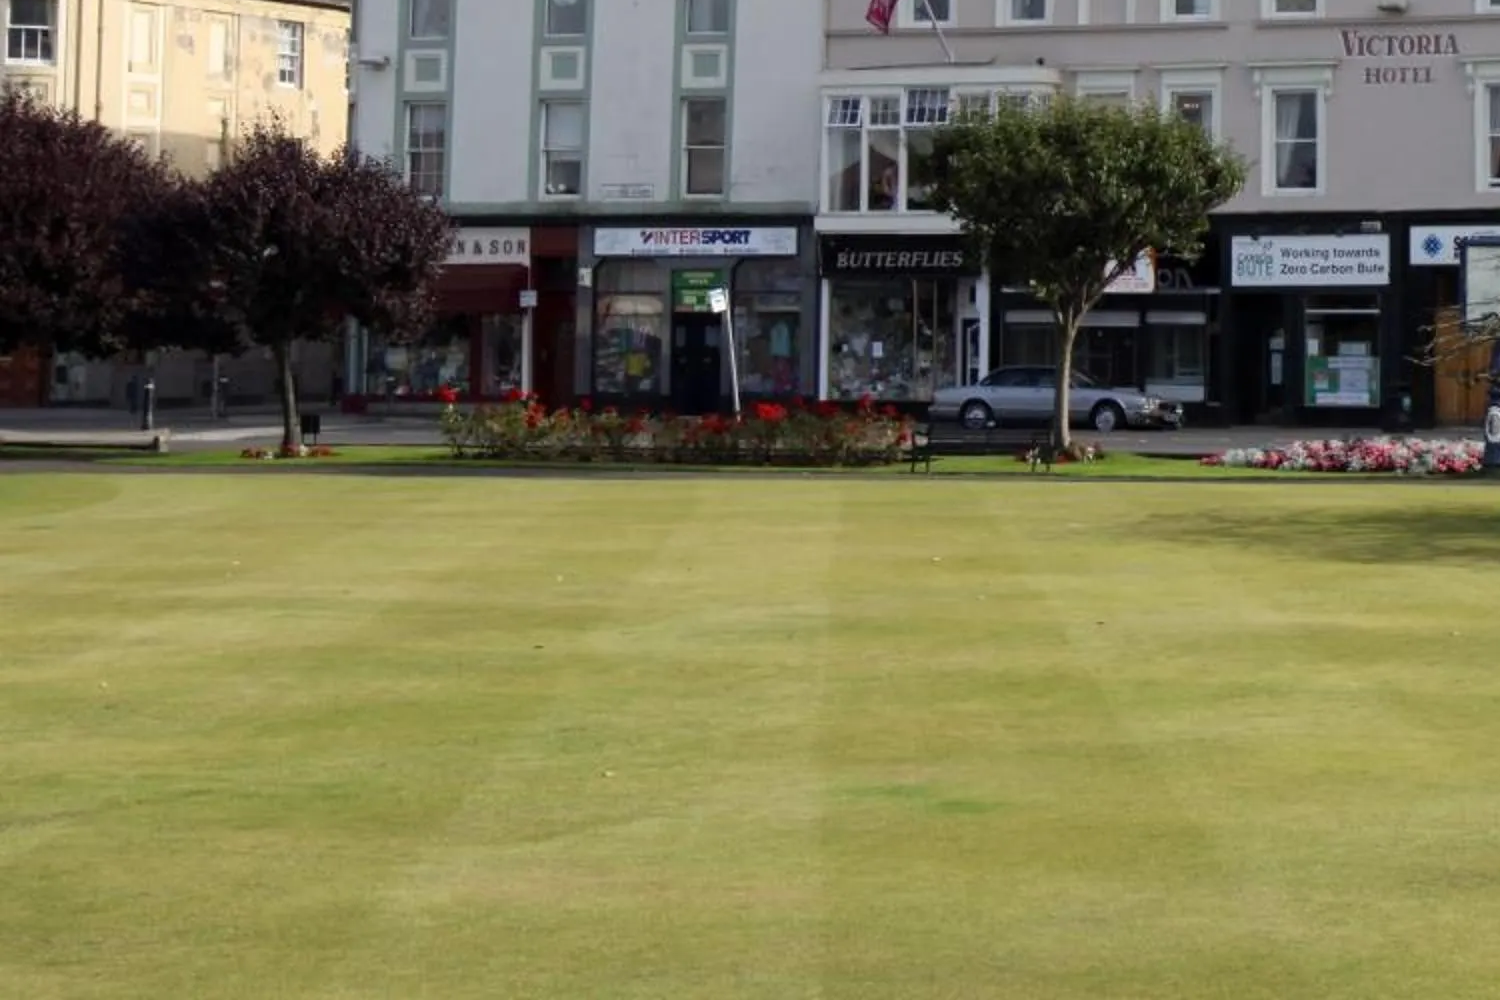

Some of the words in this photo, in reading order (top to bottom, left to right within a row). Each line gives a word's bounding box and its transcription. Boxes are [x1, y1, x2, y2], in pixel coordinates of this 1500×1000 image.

[1341, 30, 1460, 56] VICTORIA
[1364, 66, 1432, 84] HOTEL
[654, 230, 752, 245] INTERSPORT
[488, 239, 526, 256] SON
[1279, 247, 1330, 261] Working
[1333, 247, 1381, 258] towards
[836, 251, 963, 268] BUTTERFLIES
[1279, 263, 1307, 274] Zero
[1310, 262, 1353, 275] Carbon
[1357, 262, 1385, 274] Bute
